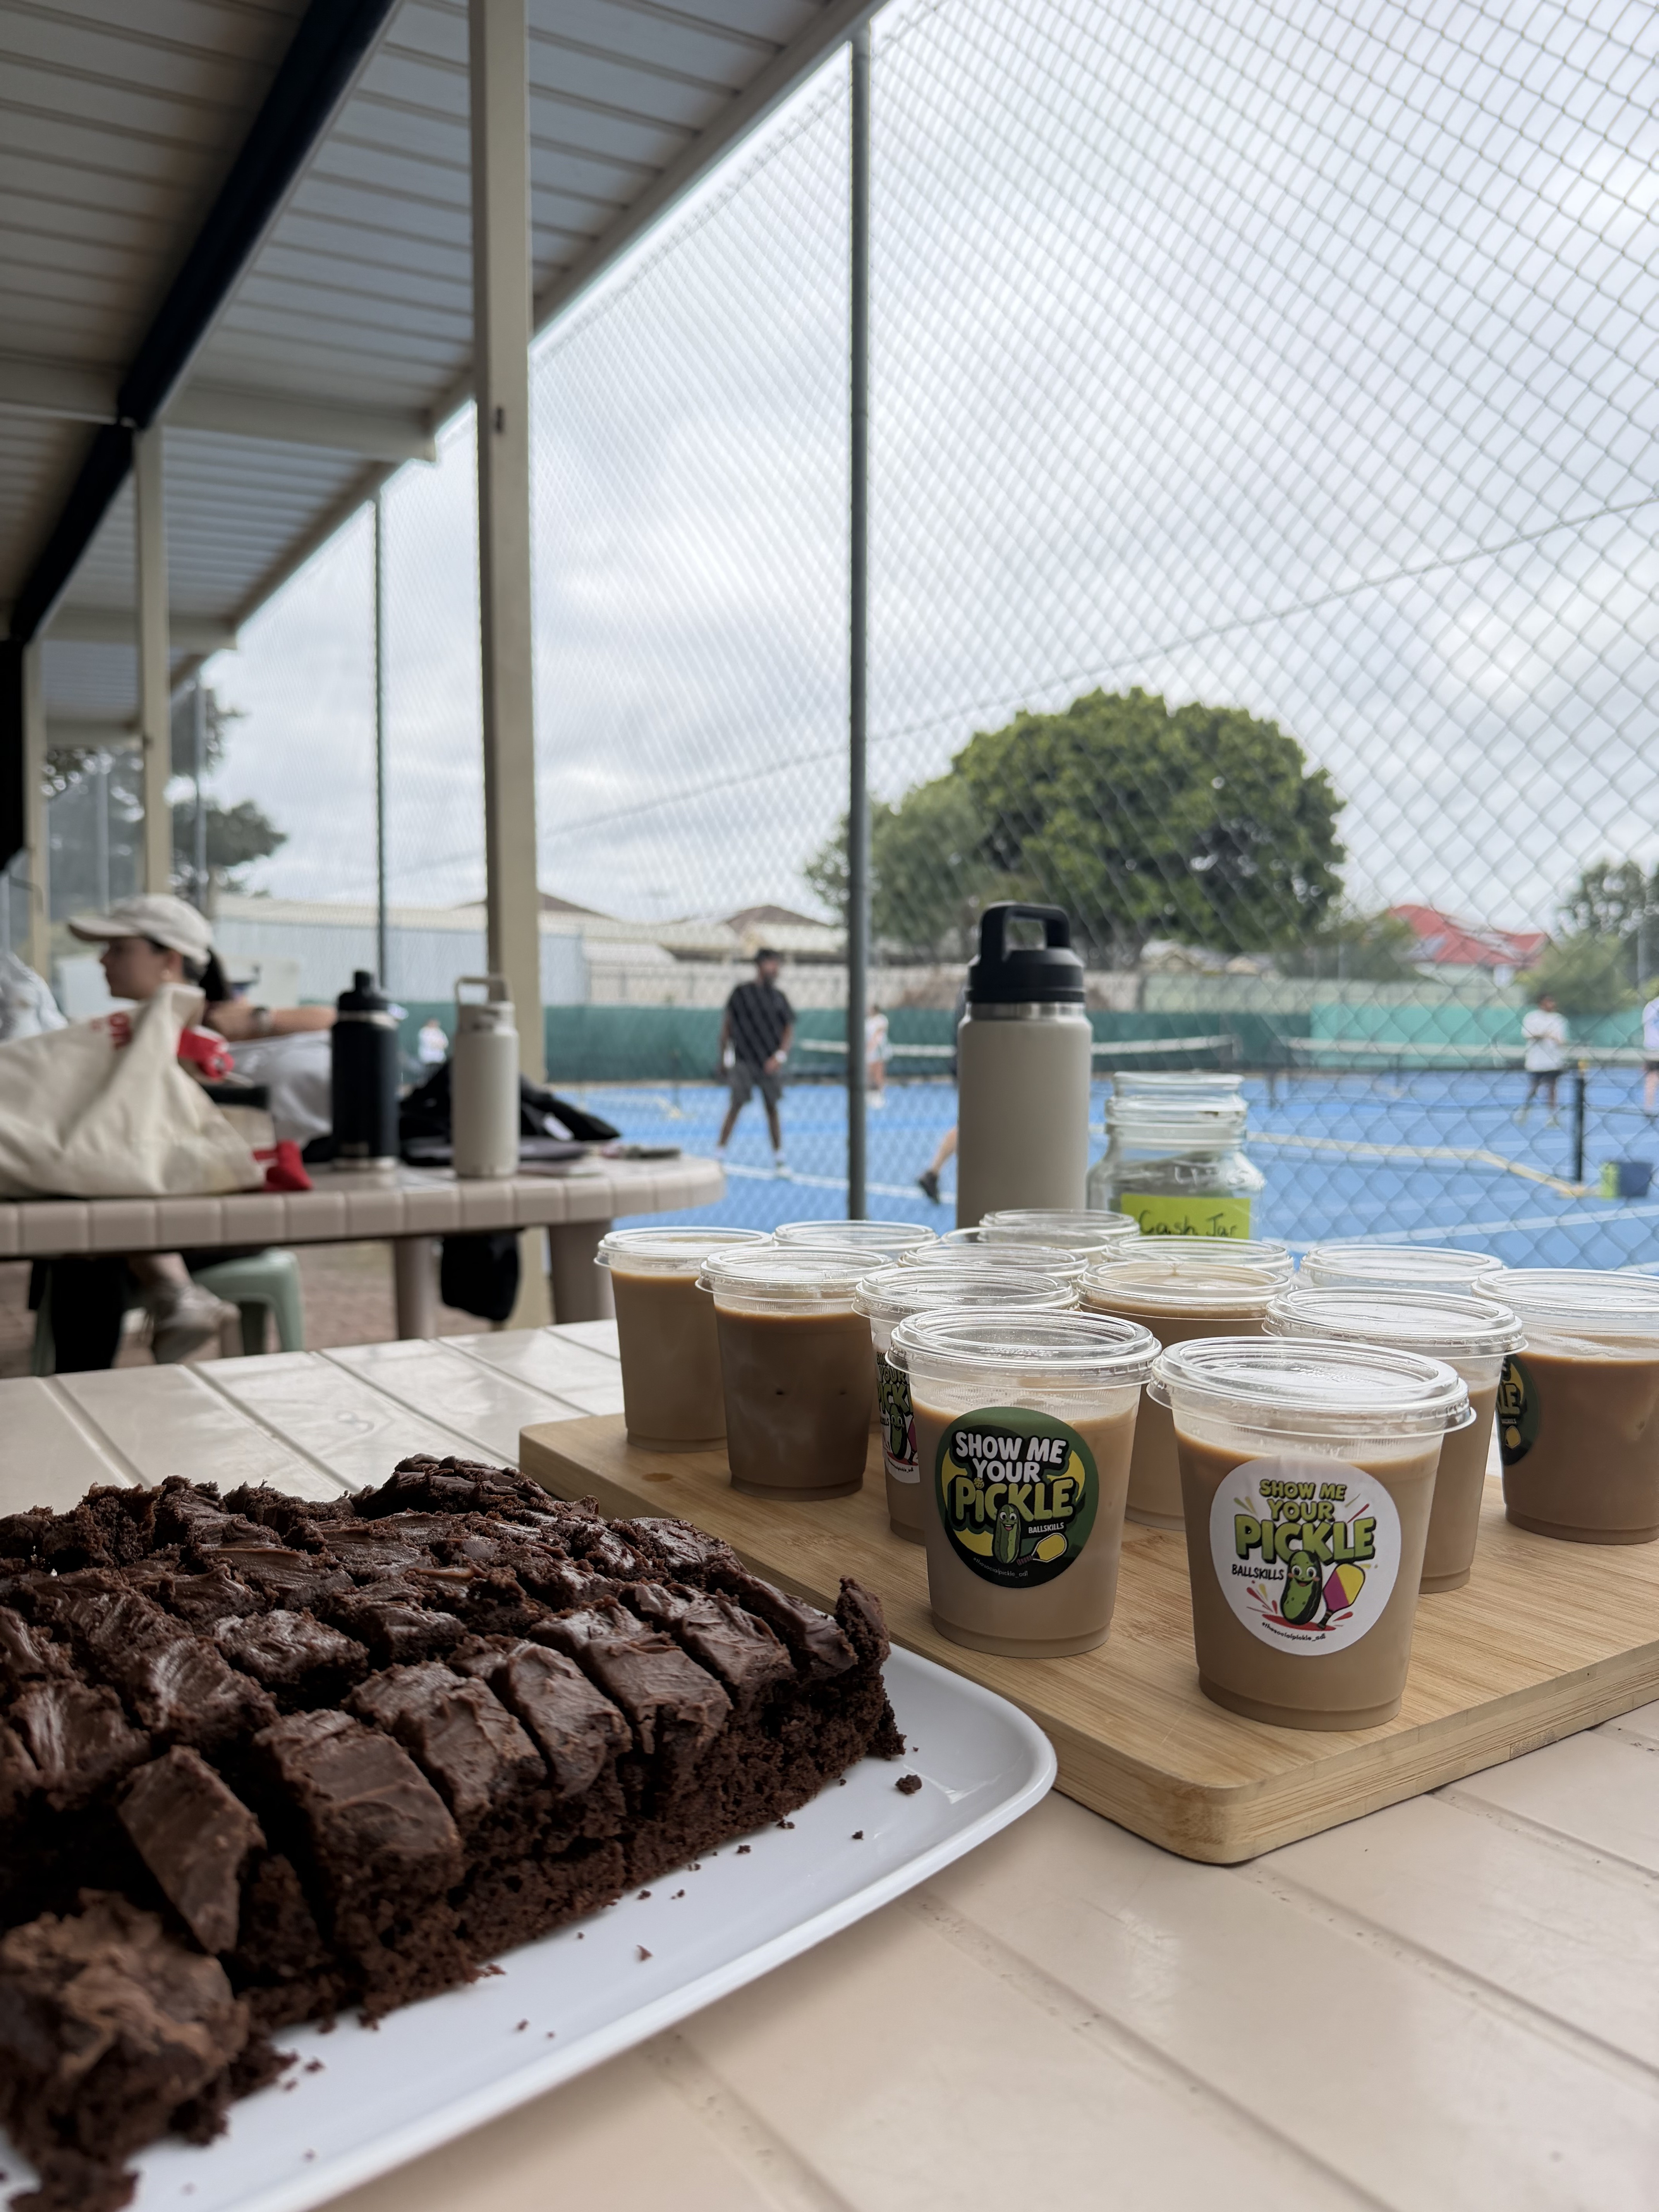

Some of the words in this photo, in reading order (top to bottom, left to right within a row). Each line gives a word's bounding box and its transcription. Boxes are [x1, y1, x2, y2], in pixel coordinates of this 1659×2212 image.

[1139, 1210, 1198, 1236] Cash
[1206, 1213, 1238, 1237] Jar
[879, 1366, 907, 1384] YOUR
[955, 1432, 1022, 1460] SHOW
[1026, 1437, 1066, 1464] ME
[972, 1458, 1041, 1483] YOUR
[1259, 1479, 1316, 1500] SHOW
[1319, 1483, 1347, 1501] ME
[1267, 1498, 1336, 1522] YOUR
[1028, 1522, 1064, 1534] BALLSKILLS
[1234, 1514, 1377, 1566] PICKLE
[1231, 1564, 1285, 1580] BALLSKILLS
